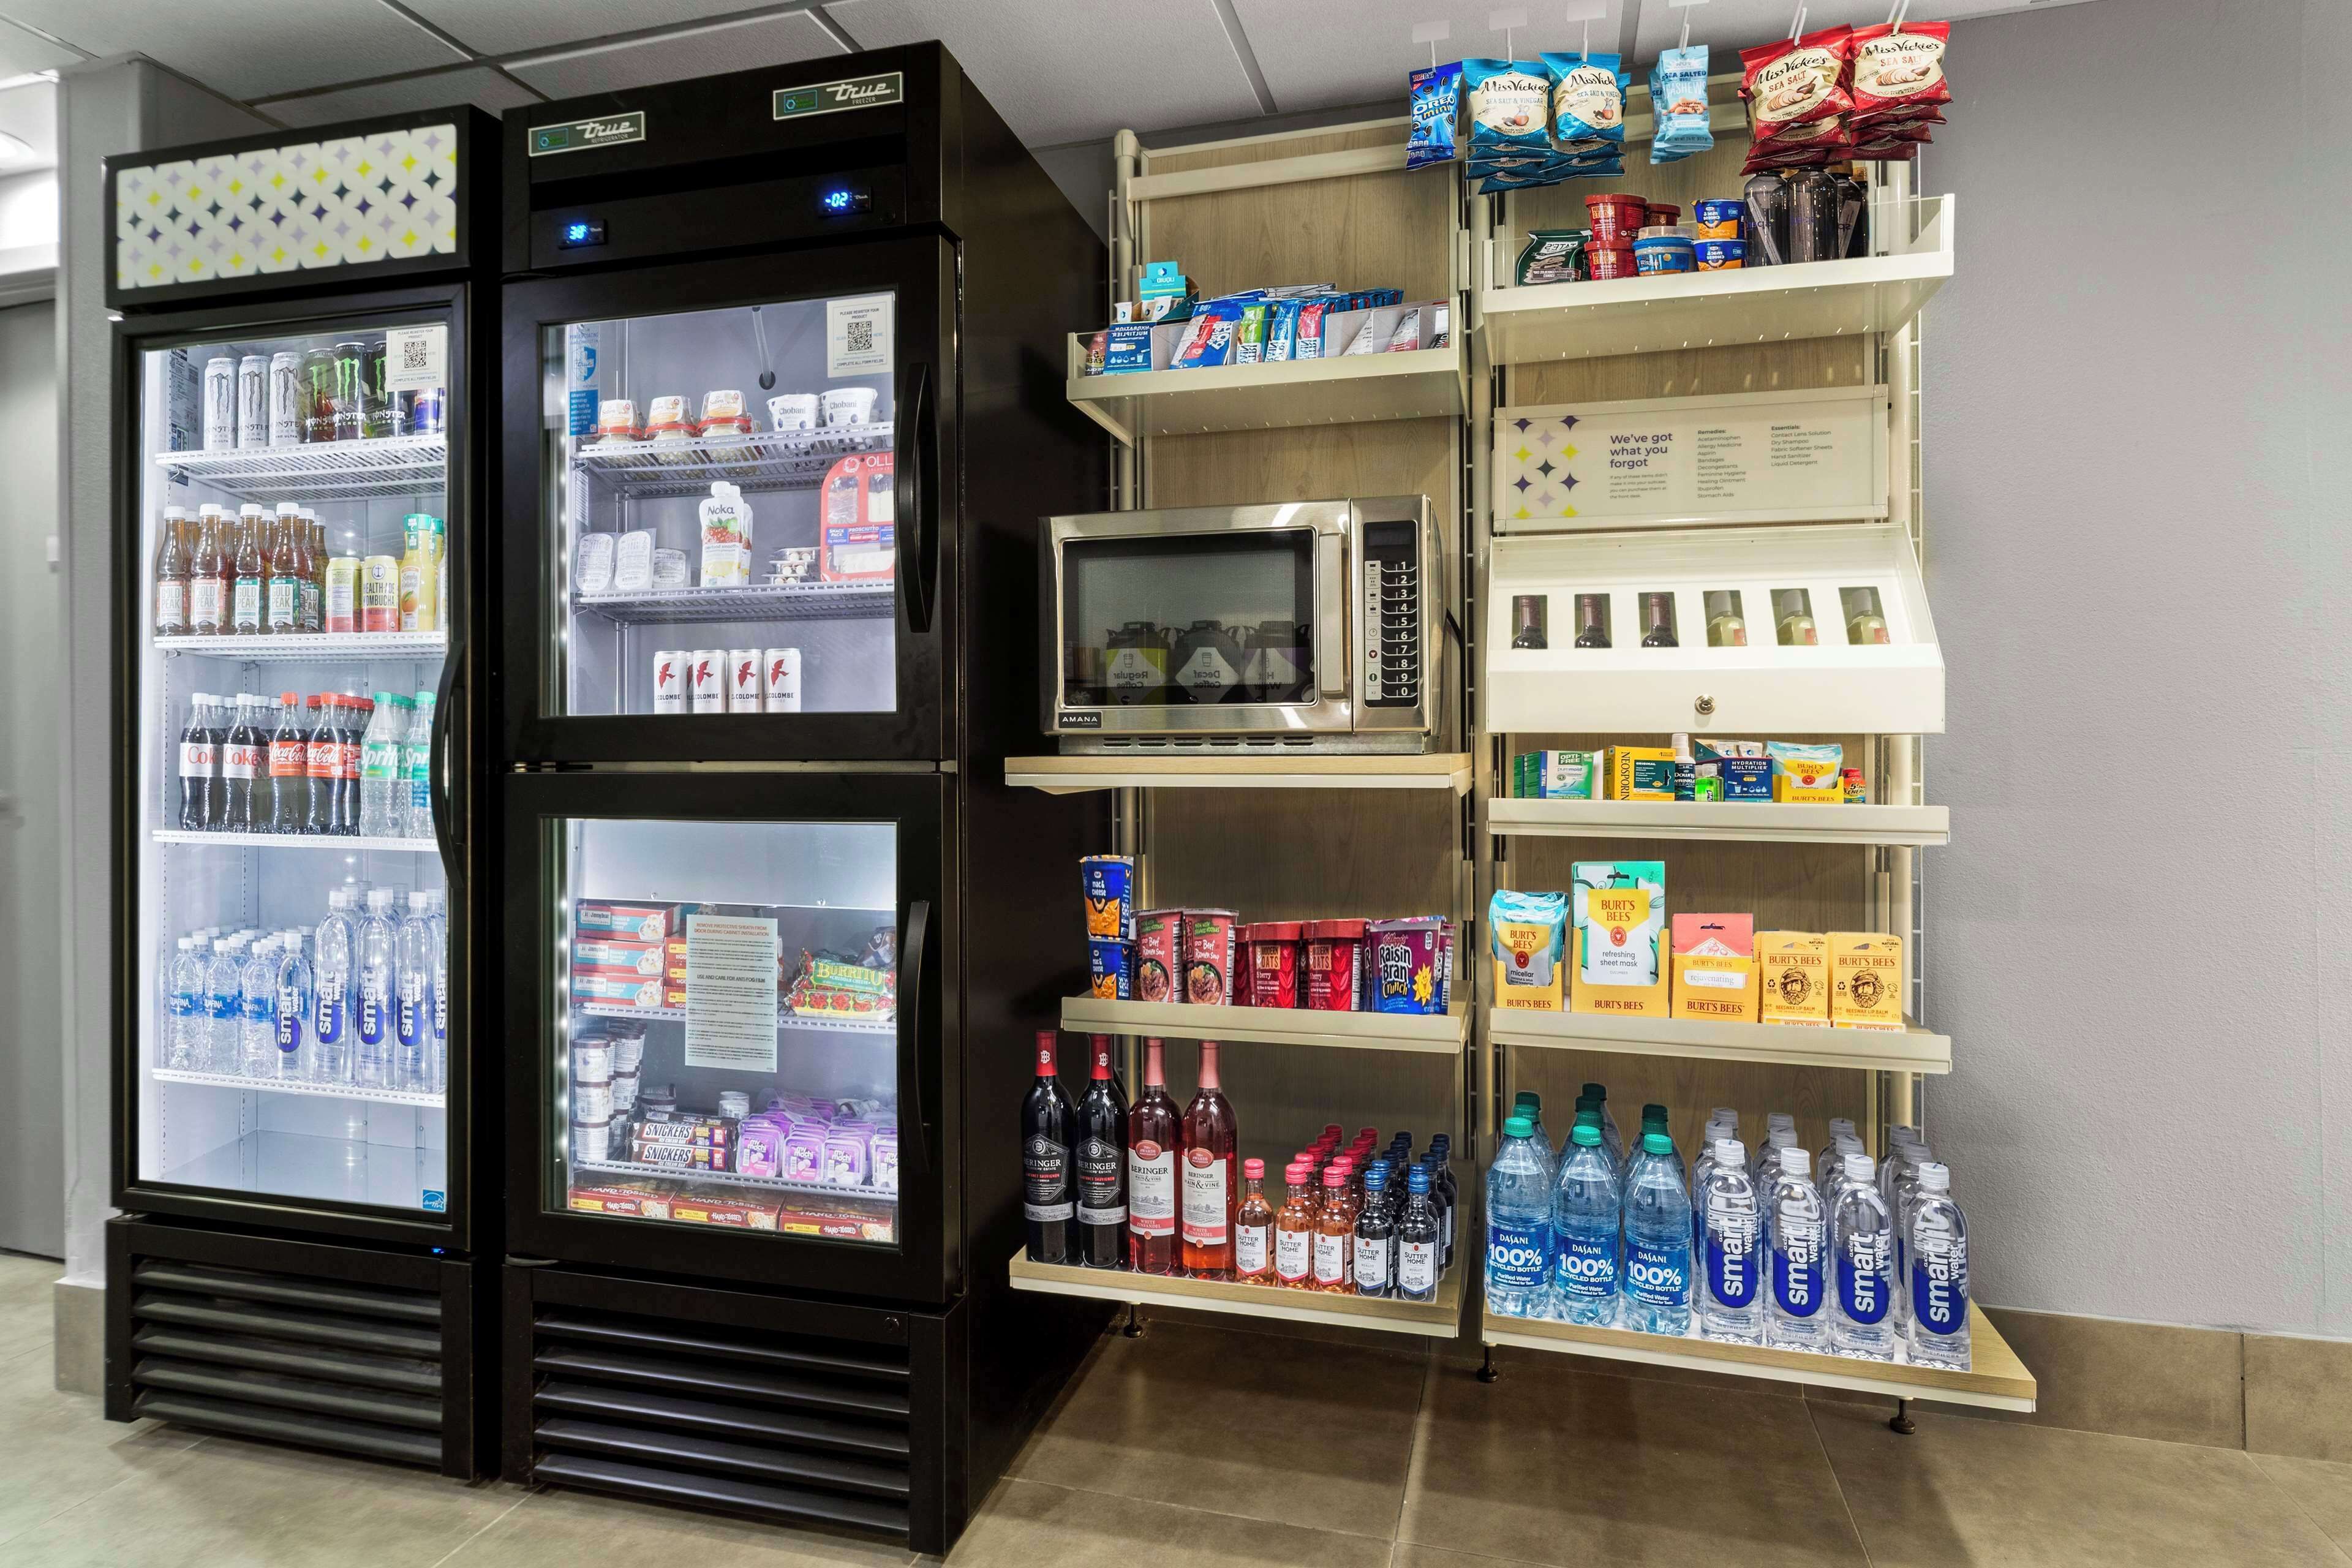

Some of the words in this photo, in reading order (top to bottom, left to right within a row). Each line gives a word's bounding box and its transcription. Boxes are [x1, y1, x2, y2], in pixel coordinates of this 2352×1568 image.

[1866, 44, 1897, 56] Miss
[1894, 39, 1940, 53] Vickie's
[1881, 57, 1898, 67] SEA
[1902, 55, 1923, 66] SALT
[1757, 67, 1785, 85] Miss
[1783, 55, 1828, 75] Vickie's
[1482, 80, 1512, 94] Miss
[1509, 80, 1549, 94] Vickie's
[1769, 81, 1785, 92] SEA
[1787, 70, 1806, 85] SALT
[1413, 96, 1454, 115] OREO
[1422, 105, 1450, 119] mini
[831, 400, 858, 410] Chobani
[779, 407, 806, 416] Chobani
[1610, 434, 1648, 444] We've
[1651, 432, 1673, 444] got
[1610, 446, 1642, 456] what
[1645, 447, 1667, 456] you
[1610, 458, 1648, 469] forgot
[707, 505, 735, 516] Noka
[1401, 561, 1406, 570] 1
[238, 587, 256, 597] GOLD
[237, 598, 256, 608] PEAK
[1401, 603, 1408, 612] 4
[1401, 631, 1408, 640] 6
[1401, 673, 1408, 682] 9
[1401, 687, 1408, 696] 0
[225, 747, 258, 766] Coke
[361, 745, 400, 765] Sprite
[1621, 752, 1630, 801] NEOSPORIN
[1601, 900, 1635, 910] BURT'S
[1607, 911, 1631, 922] BEES
[1510, 929, 1536, 940] BURT'S
[1513, 940, 1533, 949] BEES
[1379, 946, 1412, 965] Raisin
[1602, 951, 1635, 960] refreshing
[1768, 956, 1798, 965] BURT'S
[1800, 956, 1822, 965] BEES
[817, 962, 882, 986] BURRITO
[1381, 962, 1409, 981] Bran
[1510, 970, 1534, 978] micellar
[1690, 973, 1734, 985] rejuvenating
[1382, 981, 1408, 998] Crunch
[319, 971, 335, 1034] smart
[1507, 999, 1531, 1008] BURT'S
[1533, 1000, 1551, 1009] BEES
[1594, 1000, 1622, 1009] BURT'S
[1623, 1001, 1644, 1010] BEES
[1687, 1000, 1717, 1012] BURT'S
[1720, 1003, 1743, 1013] BEES
[281, 986, 292, 1044] smart
[646, 1123, 692, 1138] SNICKERS
[645, 1146, 691, 1162] SNICKERS
[747, 1144, 767, 1153] mochi
[1078, 1160, 1117, 1170] BERINGER
[1131, 1164, 1168, 1174] BERINGER
[824, 1225, 856, 1234] HAND-TOSSED
[1500, 1233, 1529, 1245] DASANI
[1357, 1247, 1379, 1256] SUTTER
[1489, 1243, 1542, 1268] 100%
[1572, 1244, 1602, 1255] DASANI
[1875, 1235, 1885, 1270] water
[1638, 1251, 1667, 1263] DASANI
[1722, 1216, 1743, 1296] smart
[1950, 1244, 1959, 1280] water
[1559, 1253, 1614, 1277] 100%
[1788, 1224, 1809, 1305] smart
[1628, 1260, 1682, 1285] 100%
[1854, 1232, 1875, 1313] smart
[1569, 1283, 1591, 1291] Purified
[1929, 1240, 1950, 1323] smart
